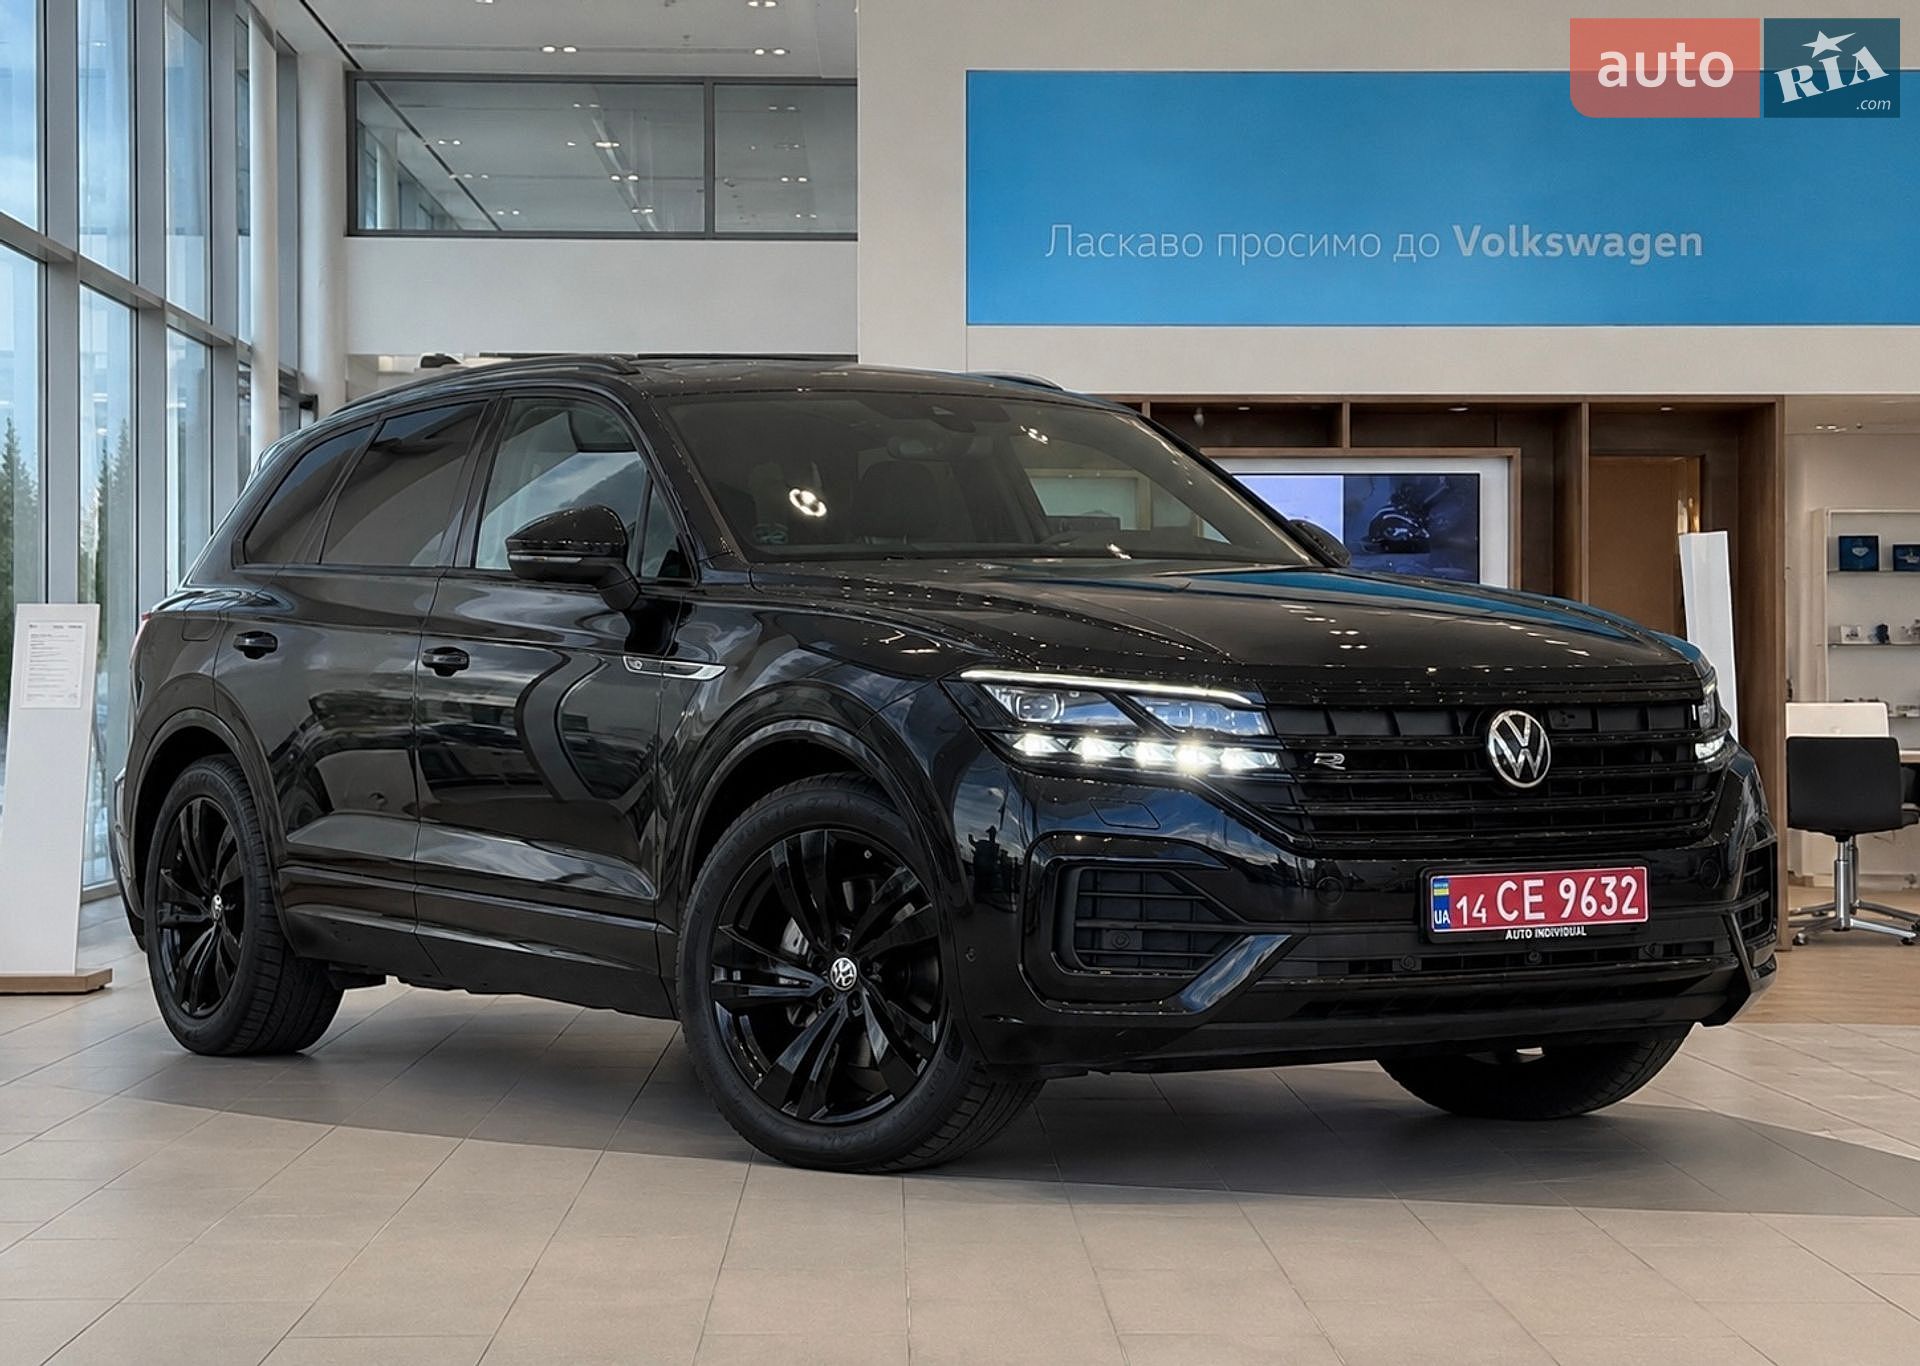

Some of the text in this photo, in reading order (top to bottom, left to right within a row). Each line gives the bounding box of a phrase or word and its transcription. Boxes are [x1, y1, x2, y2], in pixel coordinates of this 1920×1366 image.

[1045, 224, 1703, 266] Ласкаво просимо до Volkswagen
[1434, 875, 1639, 926] UA 14 CE 9632
[1505, 925, 1587, 940] AUTO INDIVIDUAL
